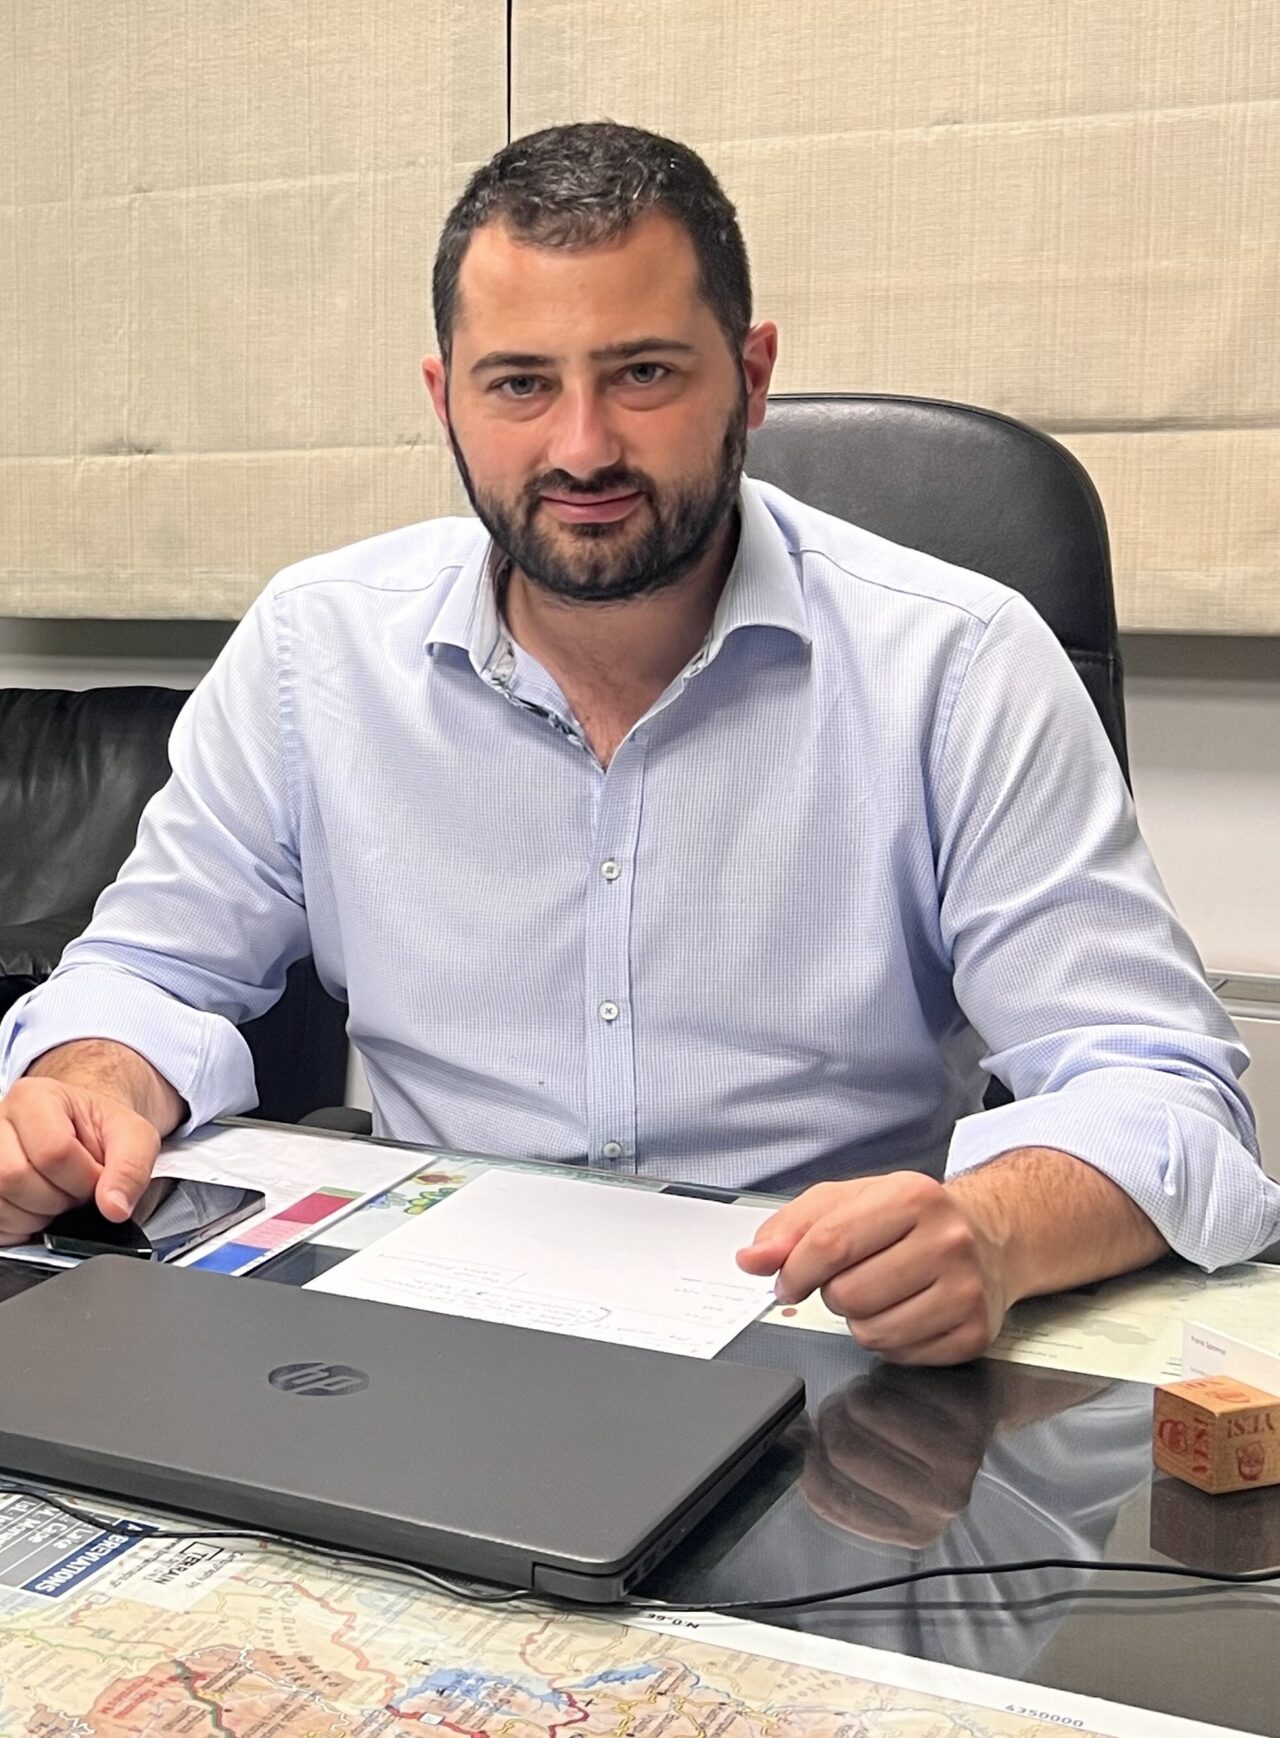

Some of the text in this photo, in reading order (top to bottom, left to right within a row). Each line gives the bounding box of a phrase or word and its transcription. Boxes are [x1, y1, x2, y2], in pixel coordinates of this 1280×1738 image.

[270, 1363, 367, 1395] hp
[25, 1521, 69, 1543] Cape
[50, 1527, 94, 1550] Lake
[31, 1523, 146, 1592] ABREVIATIONS
[151, 1550, 209, 1584] TERRAIN
[1004, 1704, 1085, 1728] 4350000
